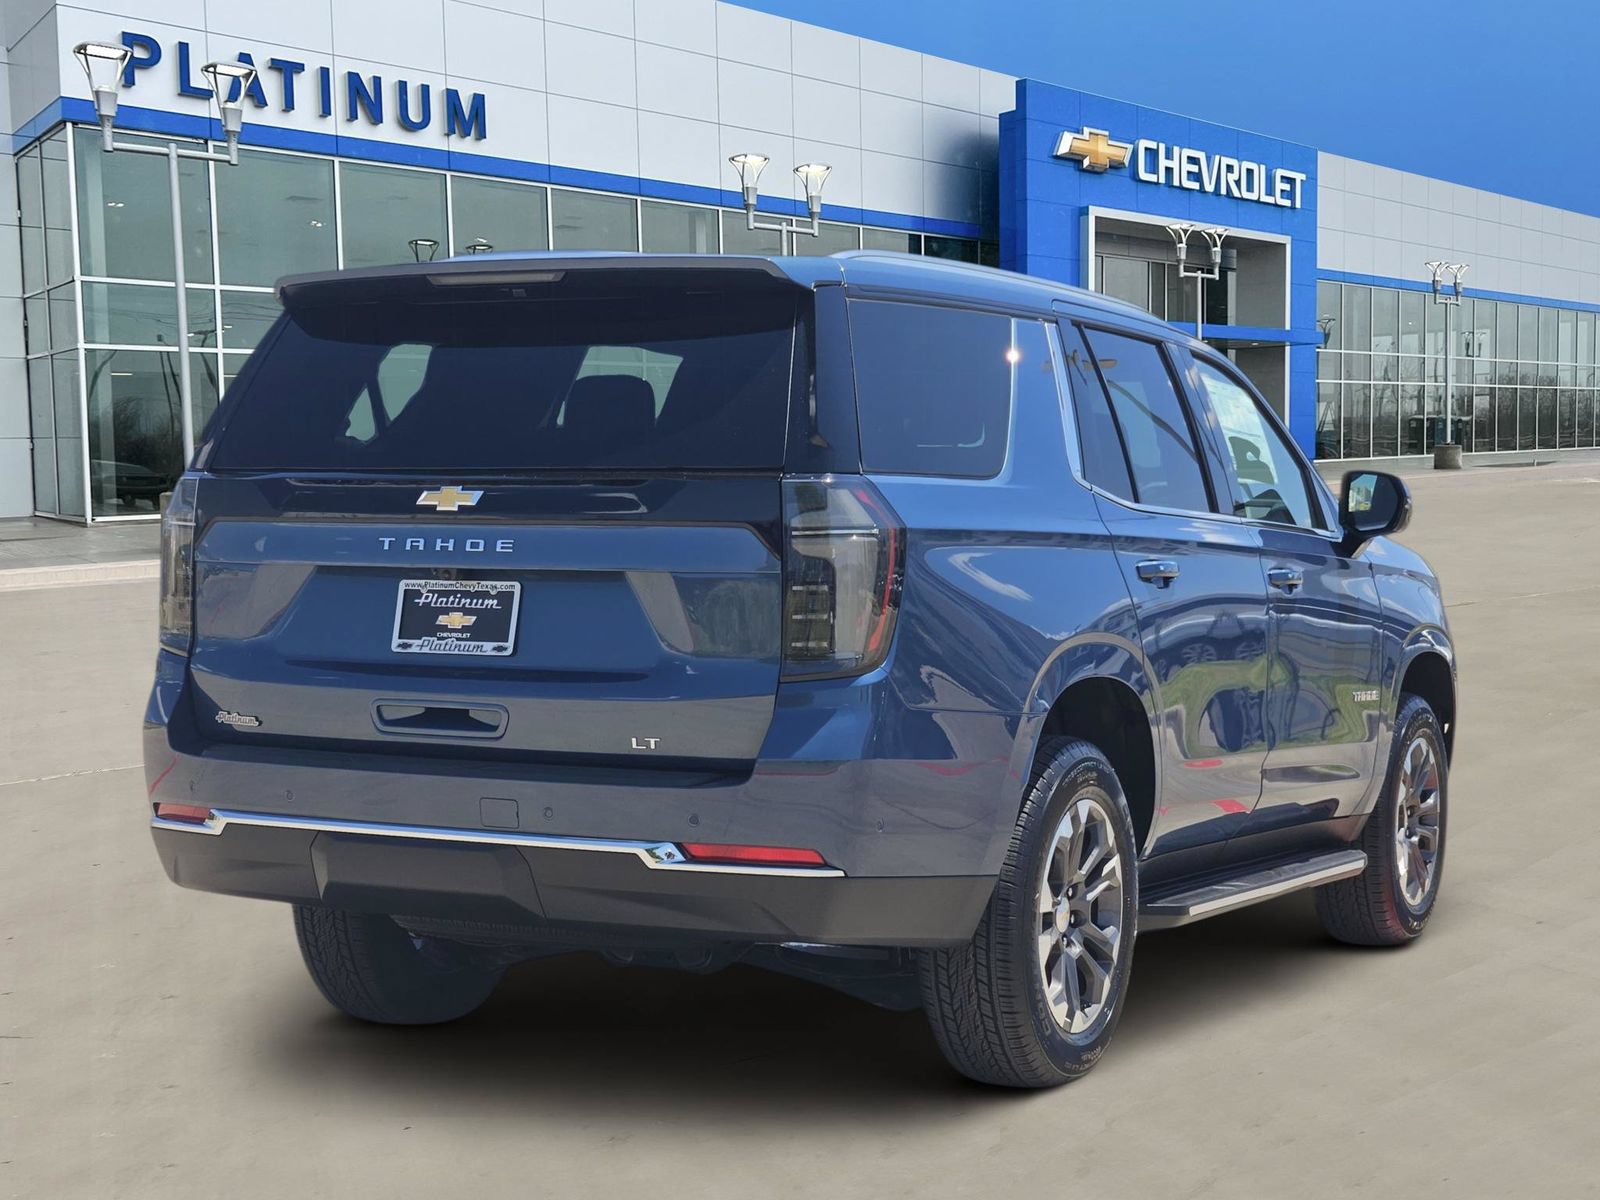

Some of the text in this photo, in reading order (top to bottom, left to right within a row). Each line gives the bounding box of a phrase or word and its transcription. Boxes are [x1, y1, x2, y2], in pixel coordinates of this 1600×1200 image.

[120, 31, 487, 140] PLATINUM
[1136, 138, 1307, 209] CHEVROLET
[379, 537, 515, 552] TAHOE
[414, 593, 502, 609] Platinum
[416, 638, 488, 653] Platinum
[631, 737, 661, 750] LT
